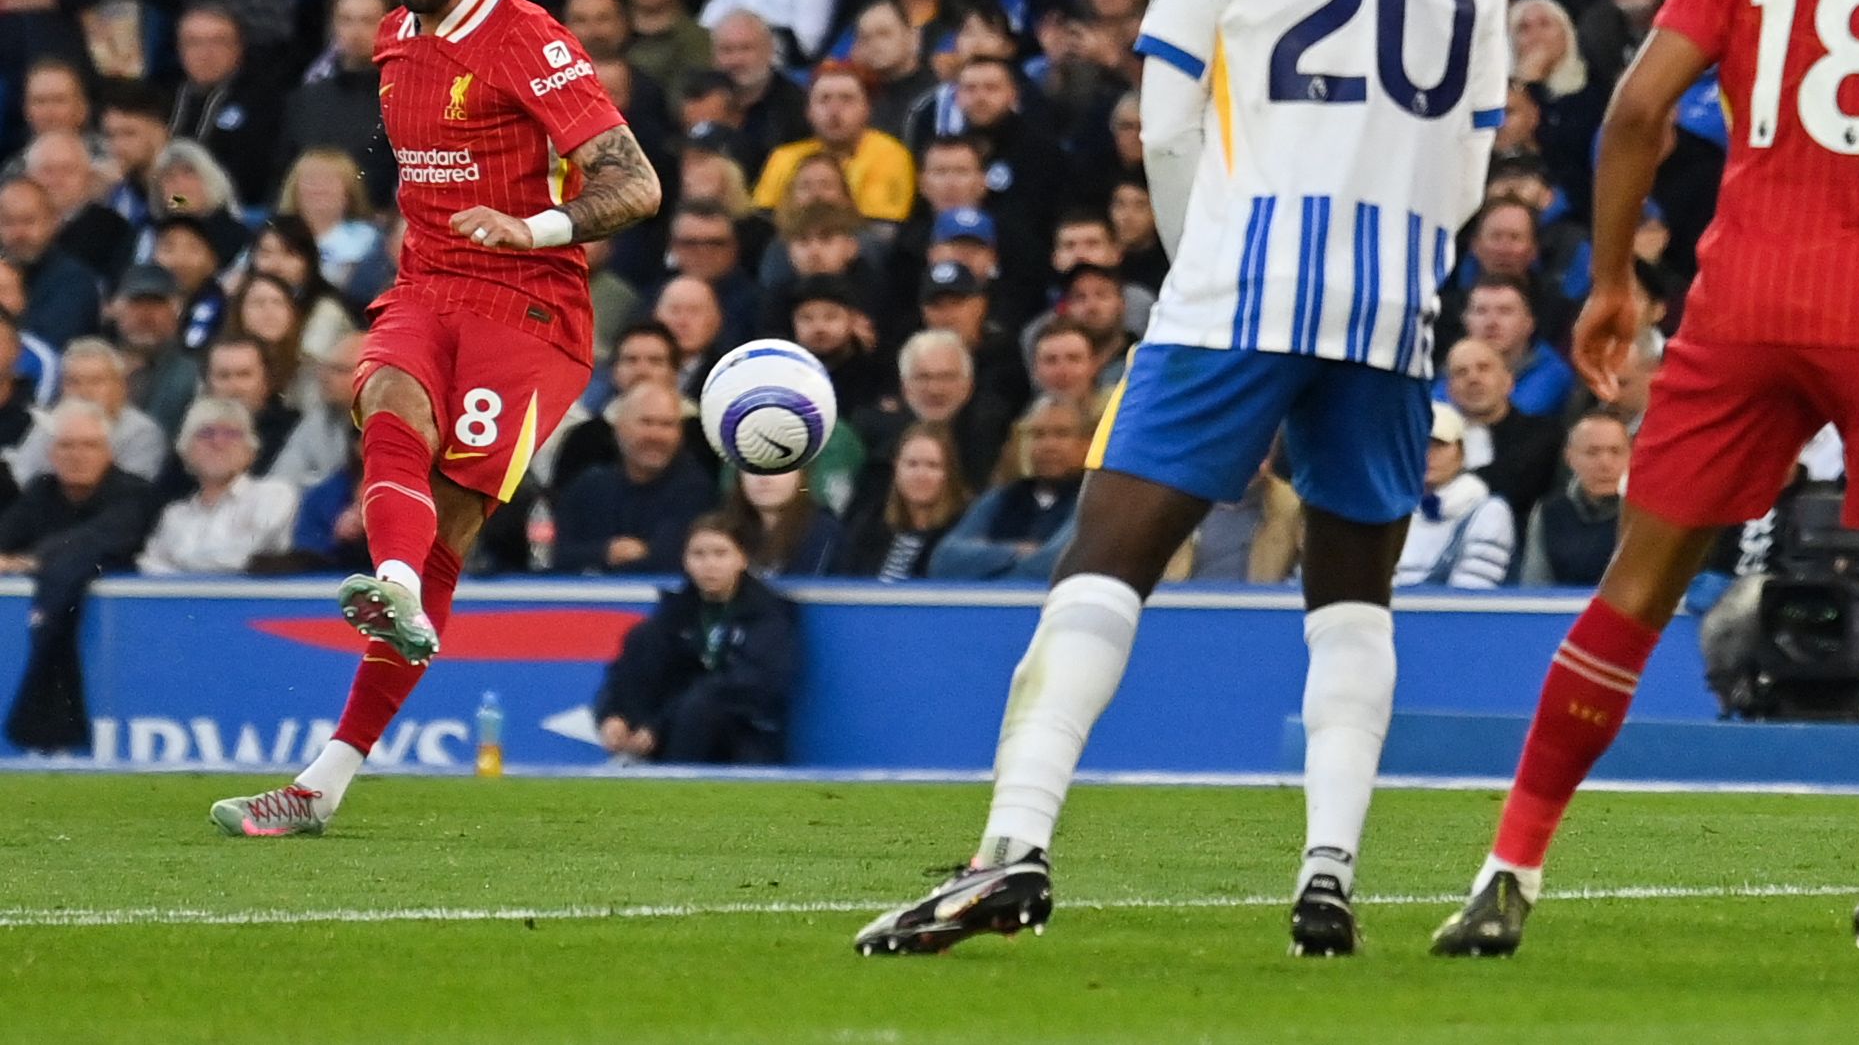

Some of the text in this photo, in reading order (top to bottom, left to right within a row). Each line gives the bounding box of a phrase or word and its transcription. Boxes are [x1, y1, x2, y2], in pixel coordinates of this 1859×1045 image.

[443, 105, 468, 121] LFC
[397, 146, 472, 166] standard
[400, 162, 480, 184] chartered
[454, 386, 503, 447] 8
[92, 717, 469, 766] IRWYS
